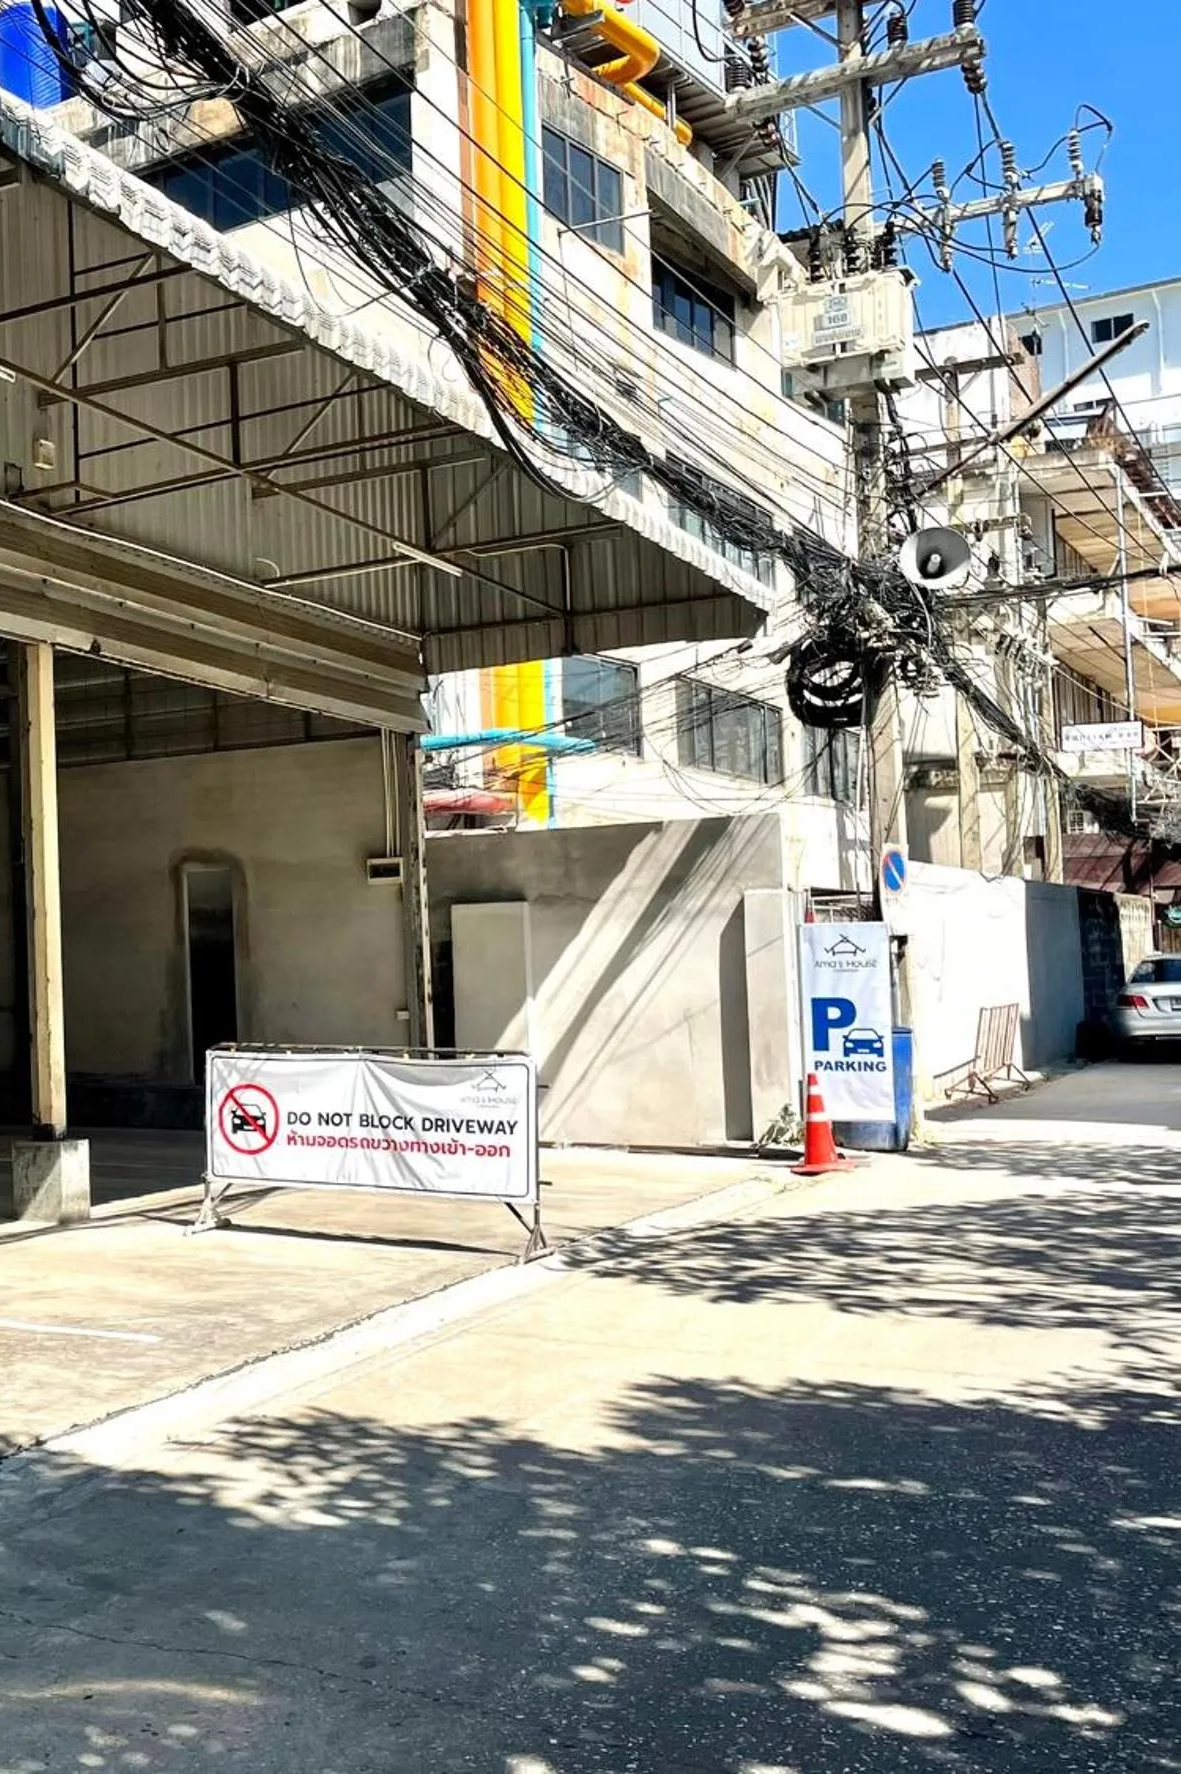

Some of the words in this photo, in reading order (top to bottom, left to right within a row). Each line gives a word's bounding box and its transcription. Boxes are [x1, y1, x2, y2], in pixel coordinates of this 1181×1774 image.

[811, 997, 858, 1052] P
[814, 1060, 888, 1073] PARKING
[287, 1111, 312, 1126] DO
[318, 1112, 353, 1128] NOT
[359, 1113, 416, 1132] BLOCK
[421, 1117, 519, 1136] DRIVEWAY
